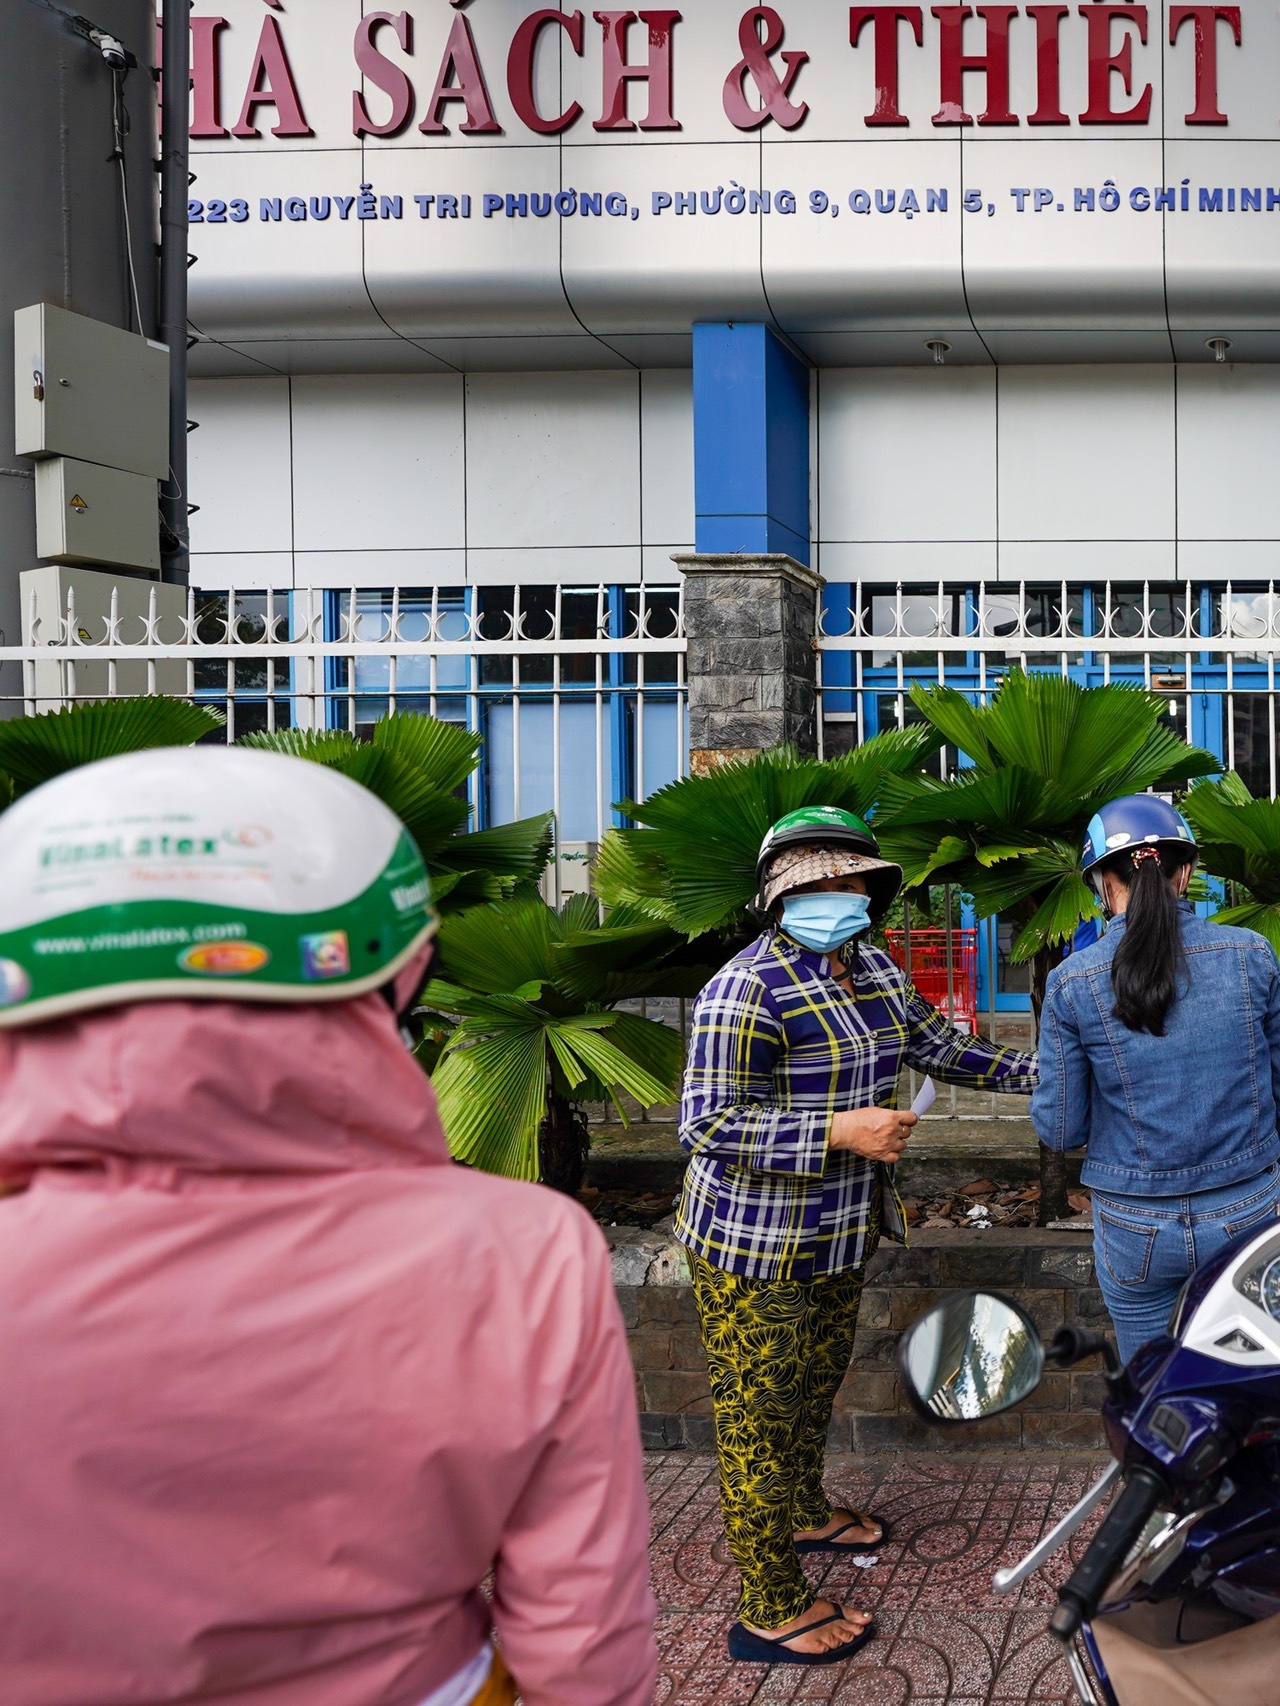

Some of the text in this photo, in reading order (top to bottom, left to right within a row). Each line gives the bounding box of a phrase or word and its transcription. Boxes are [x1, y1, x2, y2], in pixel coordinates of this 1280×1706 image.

[722, 5, 811, 132] &
[188, 198, 250, 223] 223
[259, 183, 403, 222] NGUYỄN
[414, 194, 471, 218] TRI
[651, 180, 797, 216] PHƯỜNG
[809, 190, 839, 218] 9,
[963, 188, 995, 218] 5,
[1010, 187, 1065, 212] TP.
[1129, 178, 1191, 212] CHÍ
